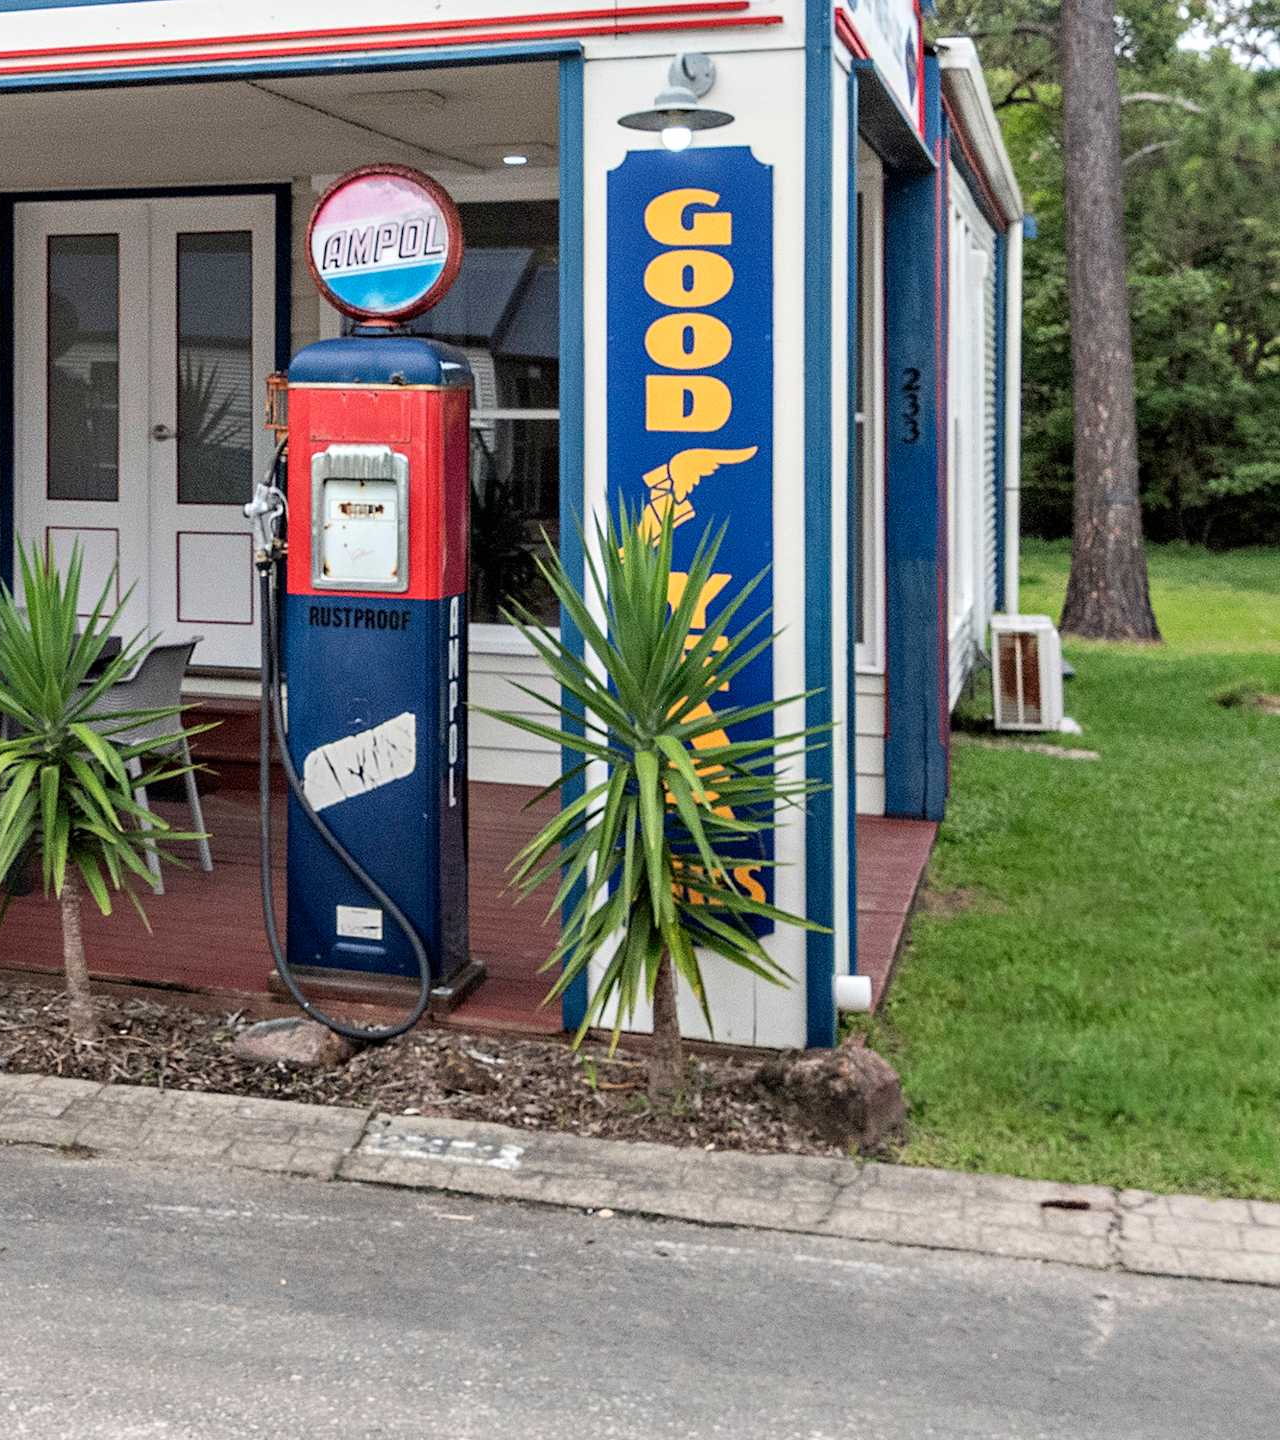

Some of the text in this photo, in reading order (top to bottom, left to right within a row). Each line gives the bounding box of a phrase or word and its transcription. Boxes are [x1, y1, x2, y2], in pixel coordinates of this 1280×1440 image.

[322, 215, 446, 270] AMPOL
[644, 187, 734, 432] GOOD
[308, 606, 412, 631] RUSTPROOF
[448, 596, 460, 807] AMPOL
